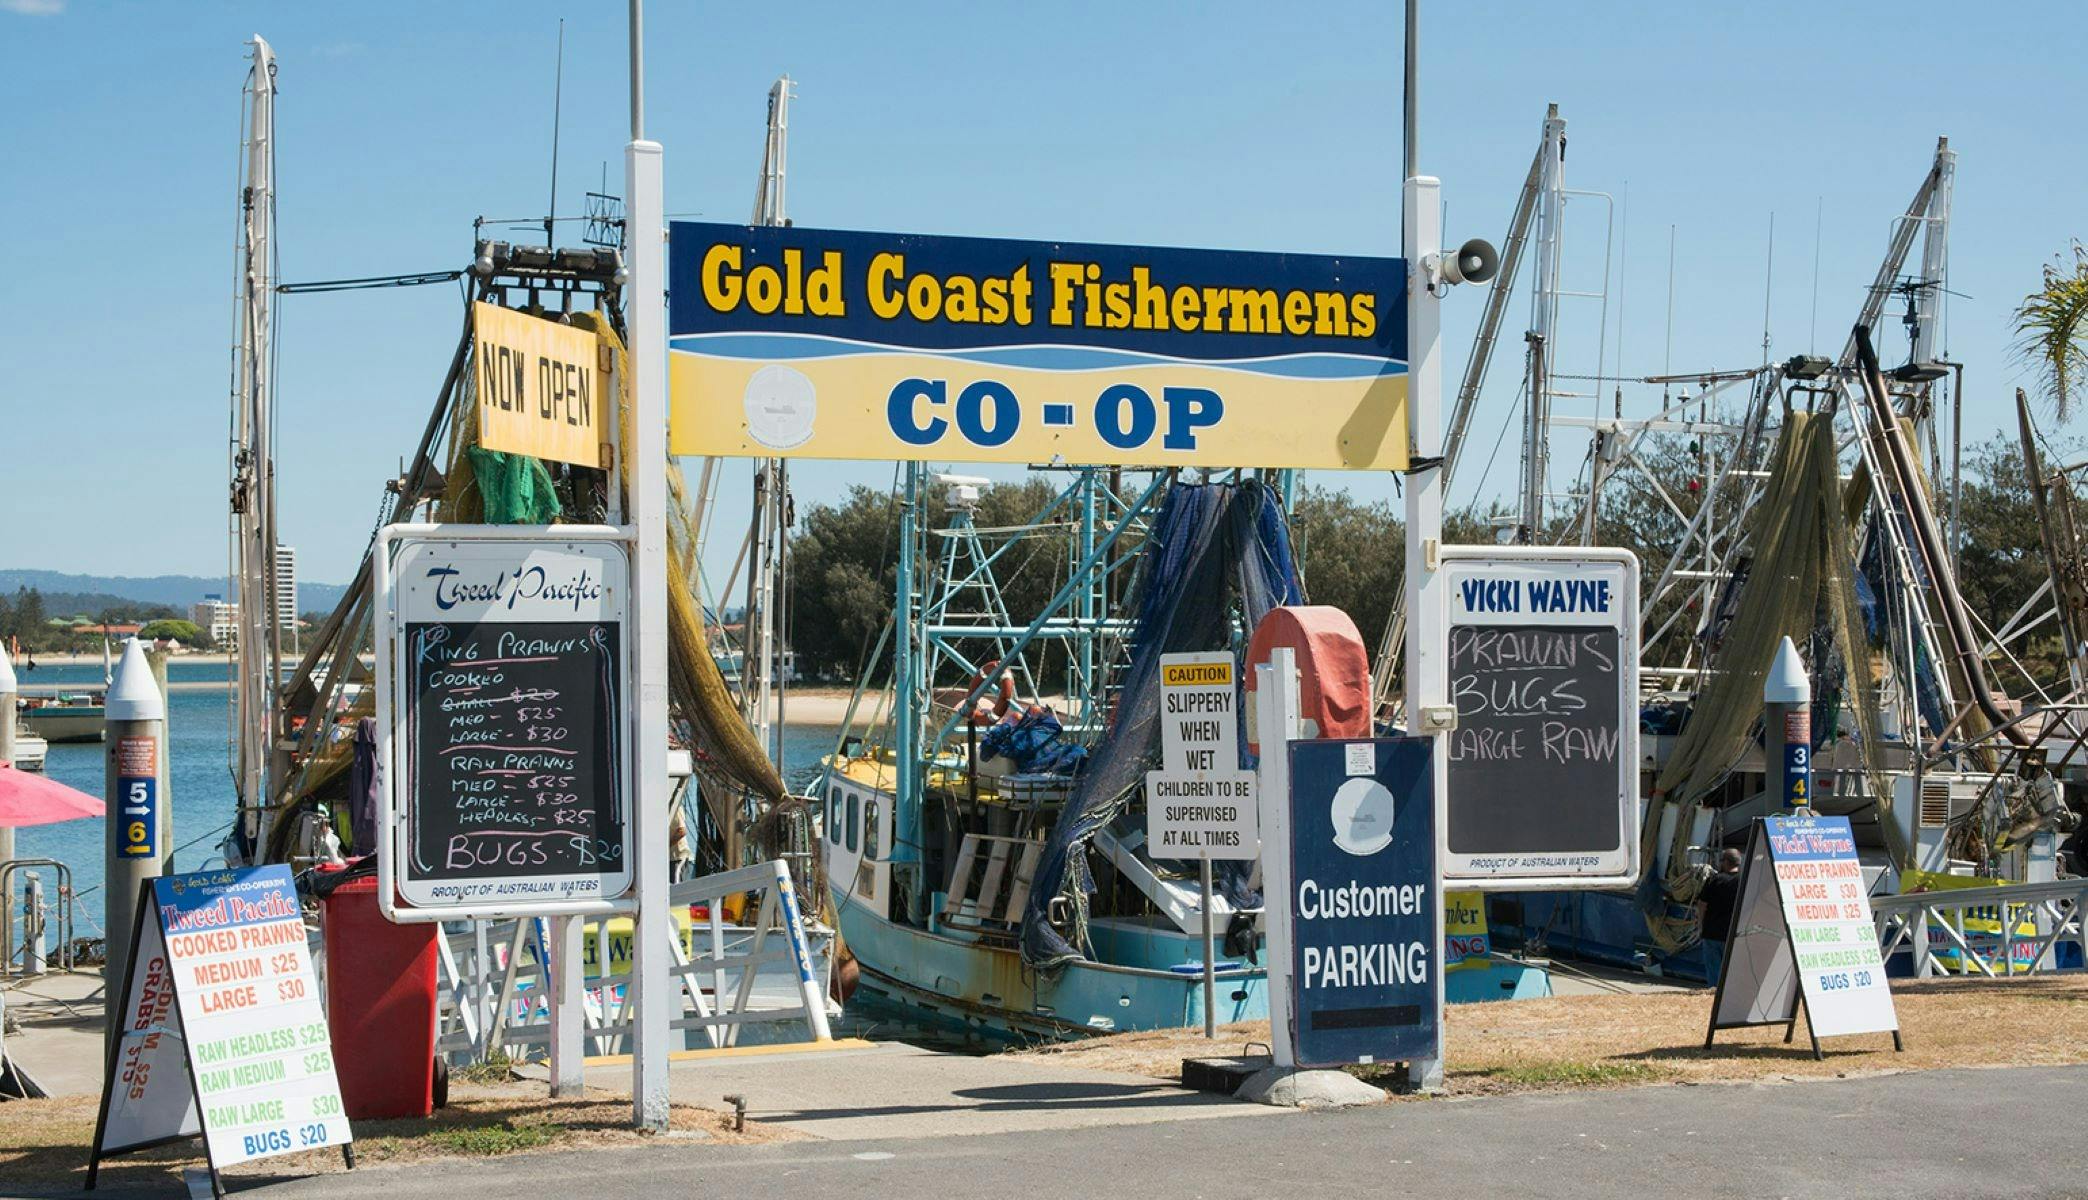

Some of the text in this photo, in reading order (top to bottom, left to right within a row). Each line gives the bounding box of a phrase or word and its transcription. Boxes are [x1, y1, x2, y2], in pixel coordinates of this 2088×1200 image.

[702, 244, 1377, 338] Gold Coast Fishermens
[483, 341, 591, 427] NOW OPEN
[427, 563, 602, 612] Tweed Pacific
[1461, 579, 1609, 613] VICKI WAYNE
[498, 632, 589, 659] PRAWNS
[1450, 626, 1614, 672] PRAWNS
[1168, 667, 1226, 682] CAUTION
[1167, 692, 1231, 713] SLIPPERY
[1451, 674, 1587, 717] BUGS
[450, 714, 484, 728] MED
[517, 707, 562, 723] $25
[450, 729, 503, 744] LARGE
[527, 724, 568, 742] $30
[1180, 721, 1220, 741] WHEN
[1449, 721, 1619, 764] LARGE RAW
[451, 753, 575, 770] RAW PRAWNS
[1186, 750, 1215, 770] WET
[1793, 747, 1807, 765] 3
[129, 782, 148, 804] 5
[452, 779, 496, 792] MED
[1156, 782, 1249, 797] CHILDREN TO BE
[1792, 779, 1806, 796] 4
[456, 795, 509, 808] LARGE
[536, 792, 578, 807] $30
[1165, 806, 1237, 821] SUPERVISED
[128, 821, 146, 842] 6
[1163, 831, 1240, 846] AT ALL TIMES
[446, 834, 548, 869] BUGS
[569, 834, 623, 866] $20
[1470, 856, 1600, 868] PRODUCT OF AUSTRALIAN WATERS
[1777, 862, 1859, 879] COOKED PRAWNS
[482, 883, 493, 894] OF
[497, 881, 554, 894] AUSTRALIAN
[1792, 883, 1857, 899] LARGE $30
[1300, 879, 1425, 919] Customer
[162, 891, 297, 931] Tweed Pacific
[1796, 904, 1861, 919] MEDIUM $25
[172, 921, 305, 958] COOKED PRAWNS
[1794, 928, 1813, 942] RAW
[1815, 926, 1841, 942] LARGE
[193, 952, 299, 986] MEDIUM $25
[1304, 941, 1427, 989] PARKING
[1800, 953, 1819, 968] RAW
[1820, 950, 1860, 967] HEADLESS
[1820, 971, 1871, 990] BUGS $20
[135, 957, 165, 1030] CRABS
[200, 978, 305, 1013] LARGE $30
[196, 1023, 327, 1064] RAW HEADLESS $25
[130, 1063, 151, 1100] $25
[201, 1052, 331, 1093] RAW MEDIUM $25
[208, 1094, 339, 1128] RAW LARGE $30
[243, 1123, 327, 1156] BUGS $20
